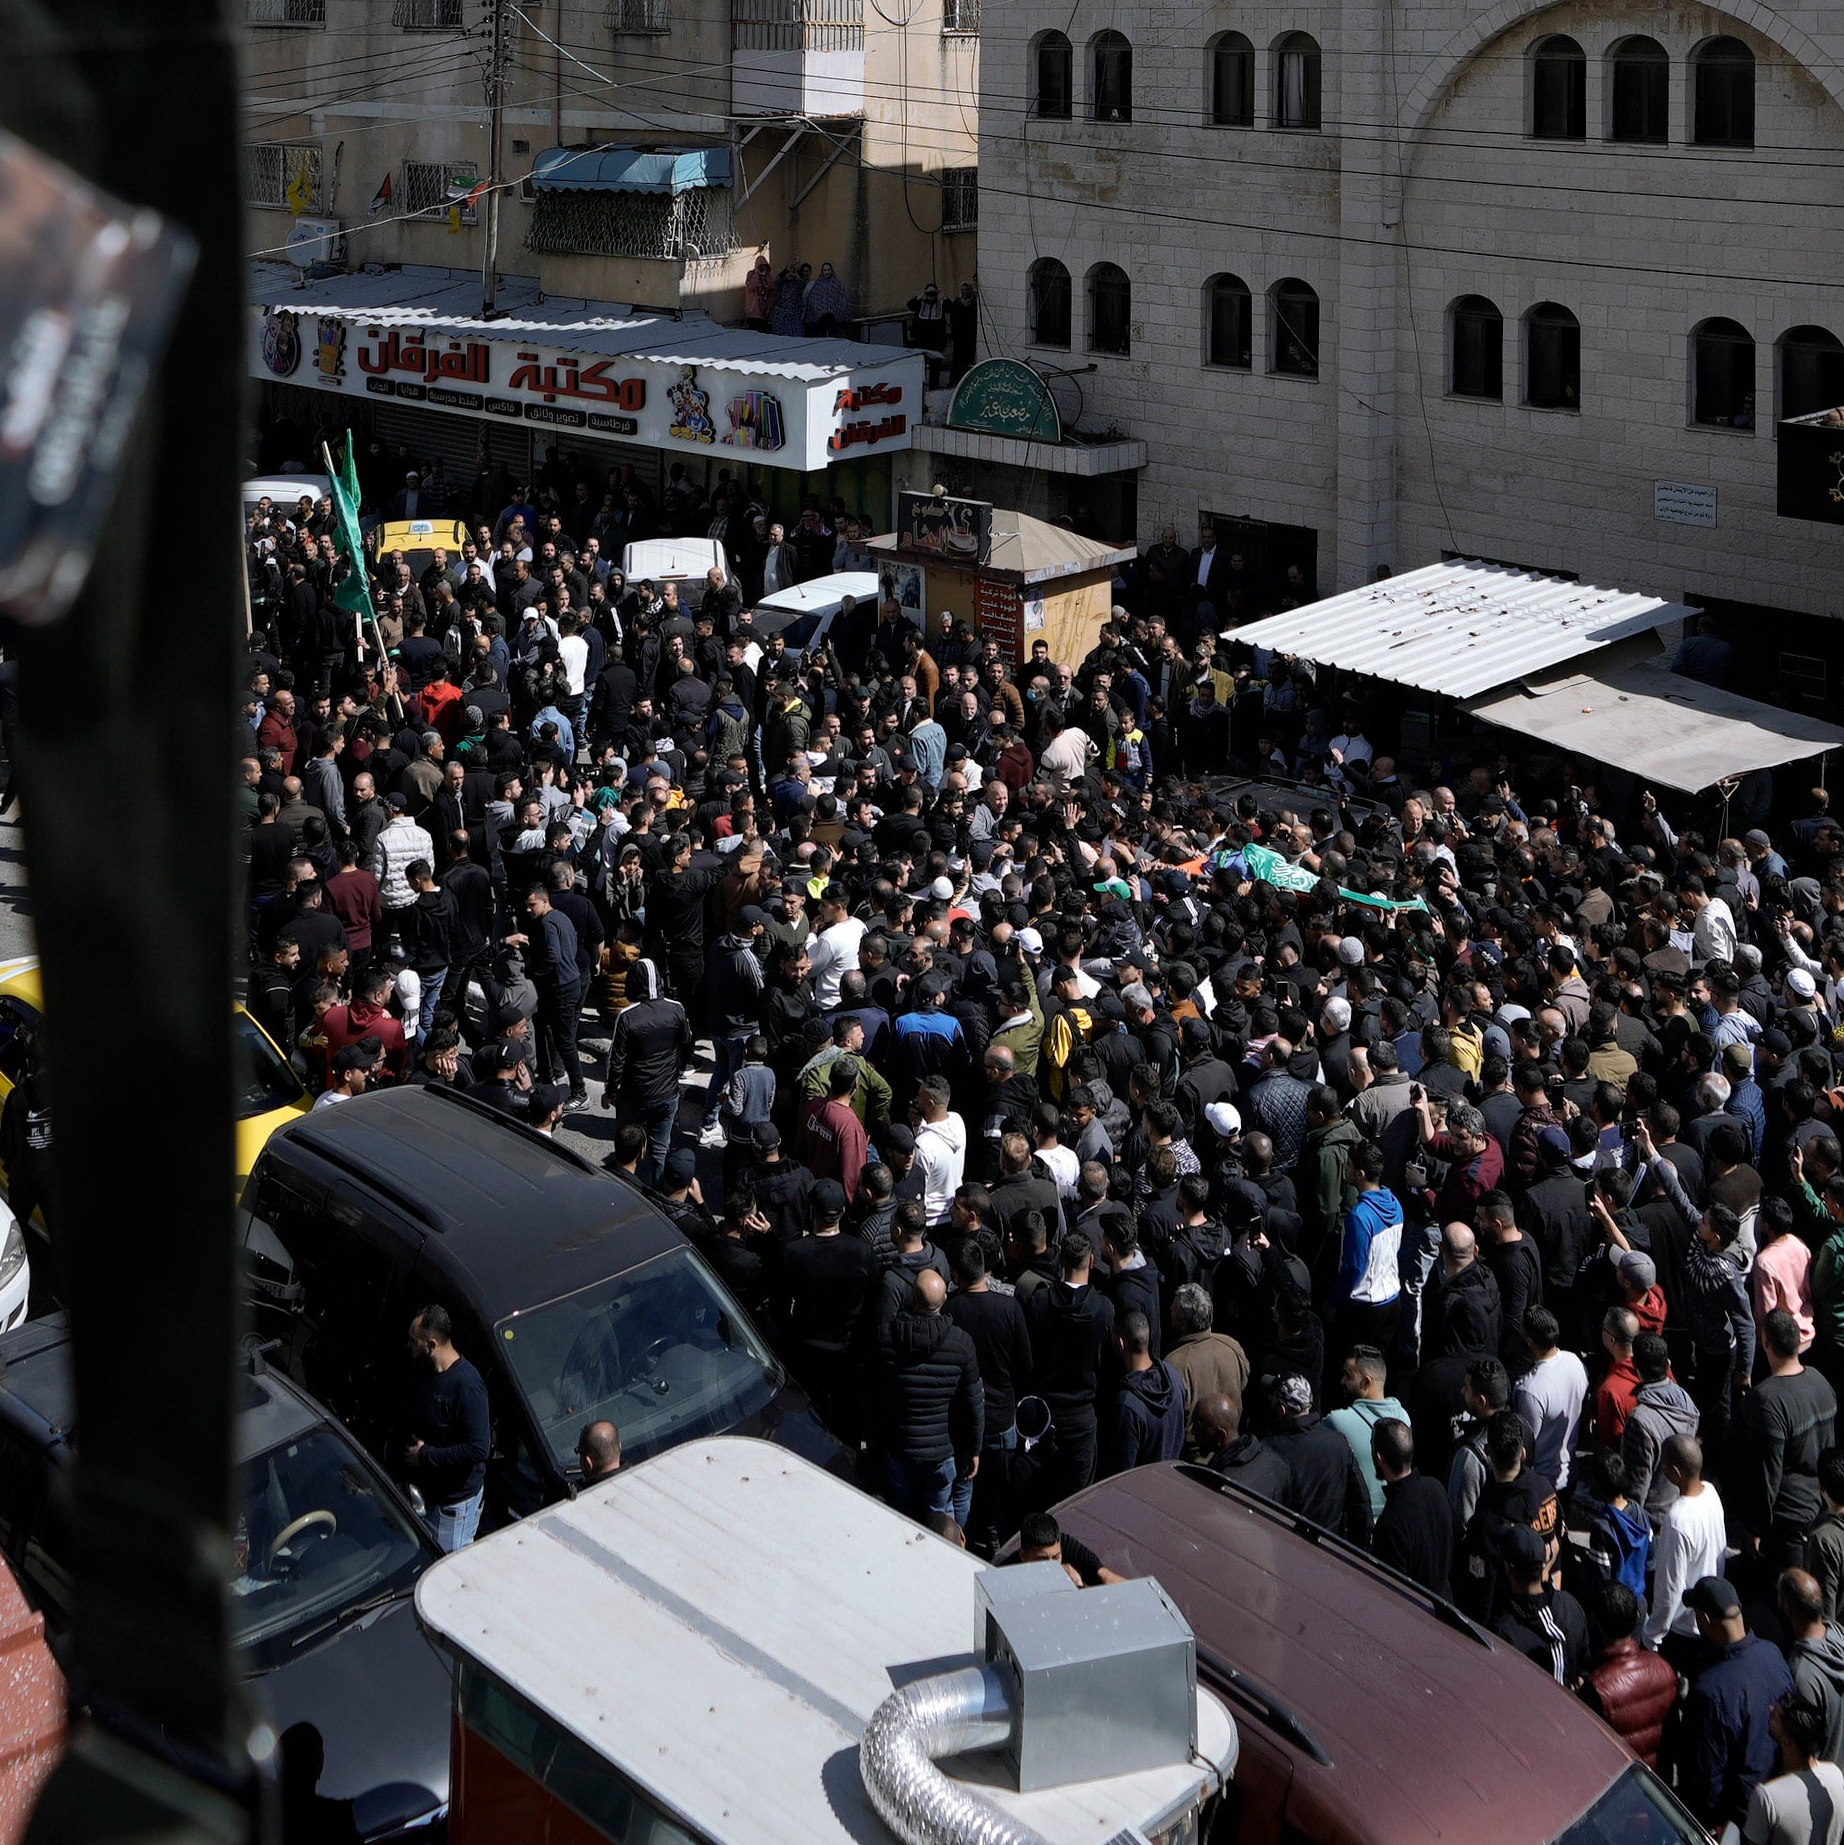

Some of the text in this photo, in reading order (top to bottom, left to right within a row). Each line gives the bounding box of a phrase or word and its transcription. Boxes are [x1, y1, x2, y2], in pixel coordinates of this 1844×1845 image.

[358, 330, 646, 412] مكتبة الفرقان
[400, 384, 420, 397] هدايا
[836, 382, 903, 412] مكتبة
[458, 395, 479, 407] شنط
[488, 401, 516, 413] فاكس
[556, 412, 580, 425] تصوير
[591, 415, 631, 433] قرطاسية
[829, 414, 907, 450] الفرقان
[898, 520, 954, 555] الشام
